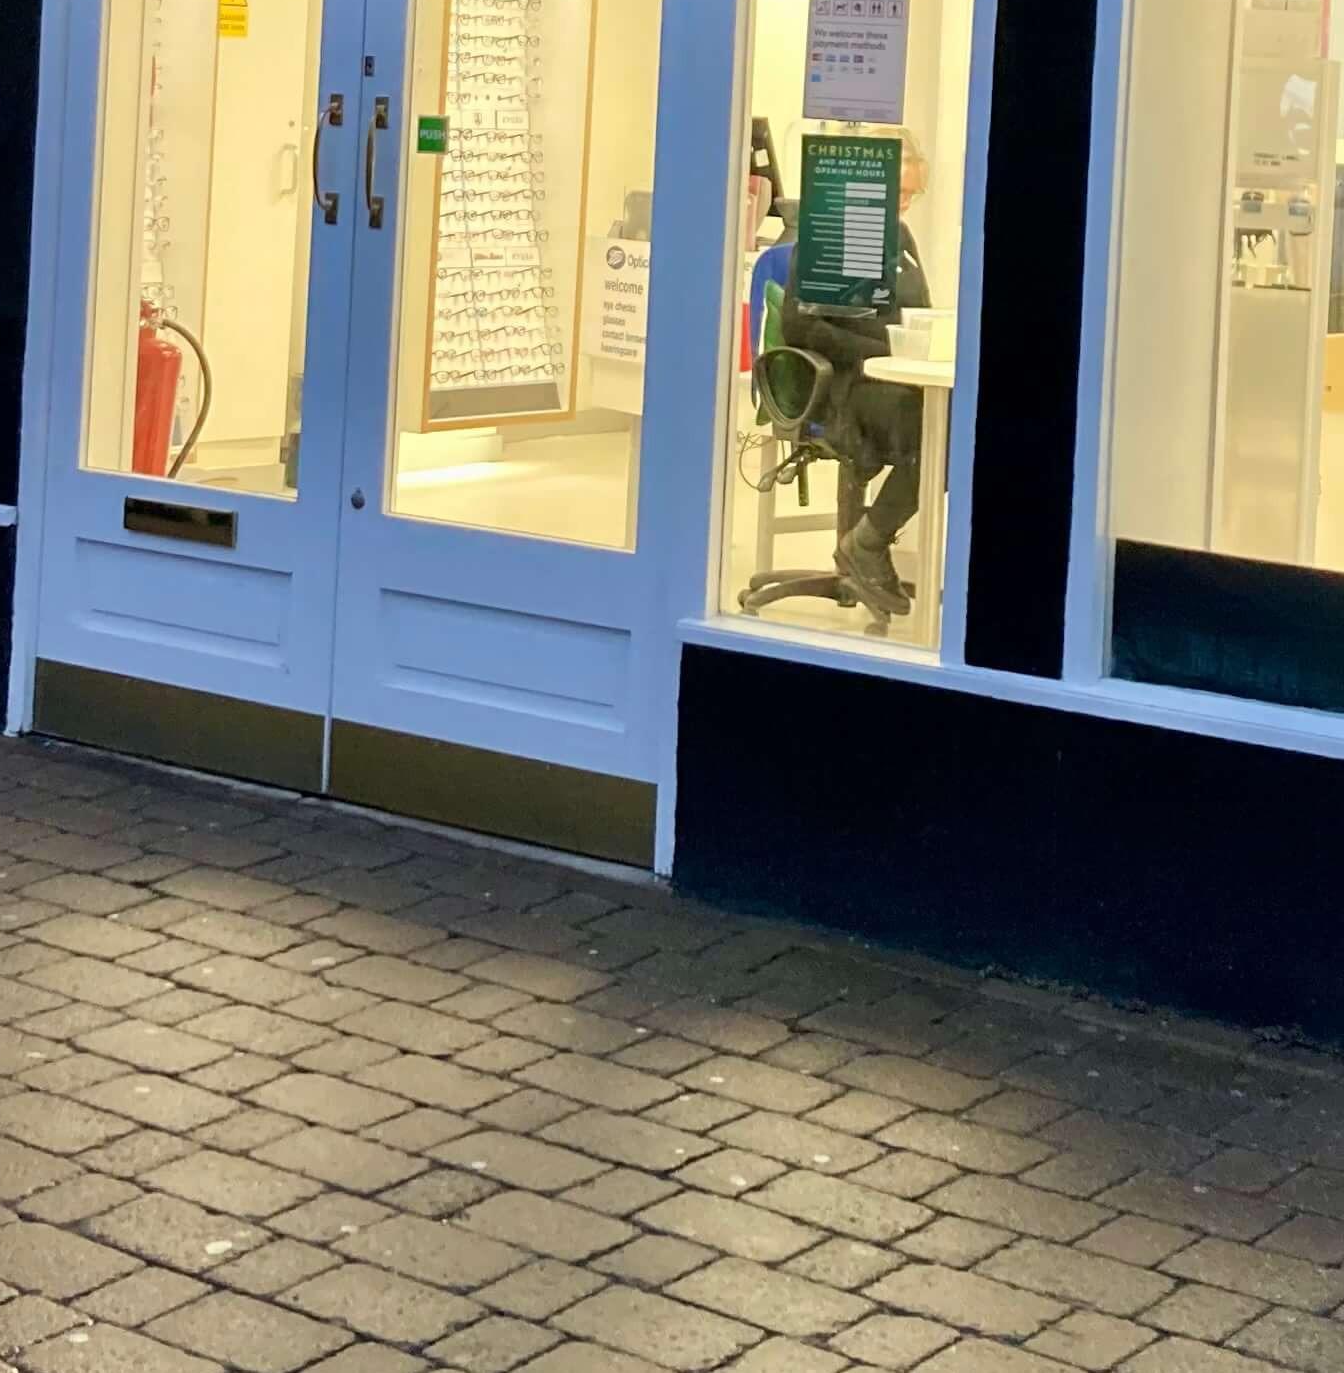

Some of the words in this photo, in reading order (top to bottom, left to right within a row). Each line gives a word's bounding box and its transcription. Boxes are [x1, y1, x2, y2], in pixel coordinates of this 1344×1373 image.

[851, 41, 886, 50] methods
[420, 129, 446, 140] PUSH
[808, 144, 894, 159] CHRISTMAS
[838, 160, 858, 168] NEW
[860, 160, 883, 168] YEAR
[815, 167, 852, 176] OPENING
[855, 169, 885, 177] HOURS
[627, 254, 649, 269] Optic
[604, 278, 644, 295] welcome
